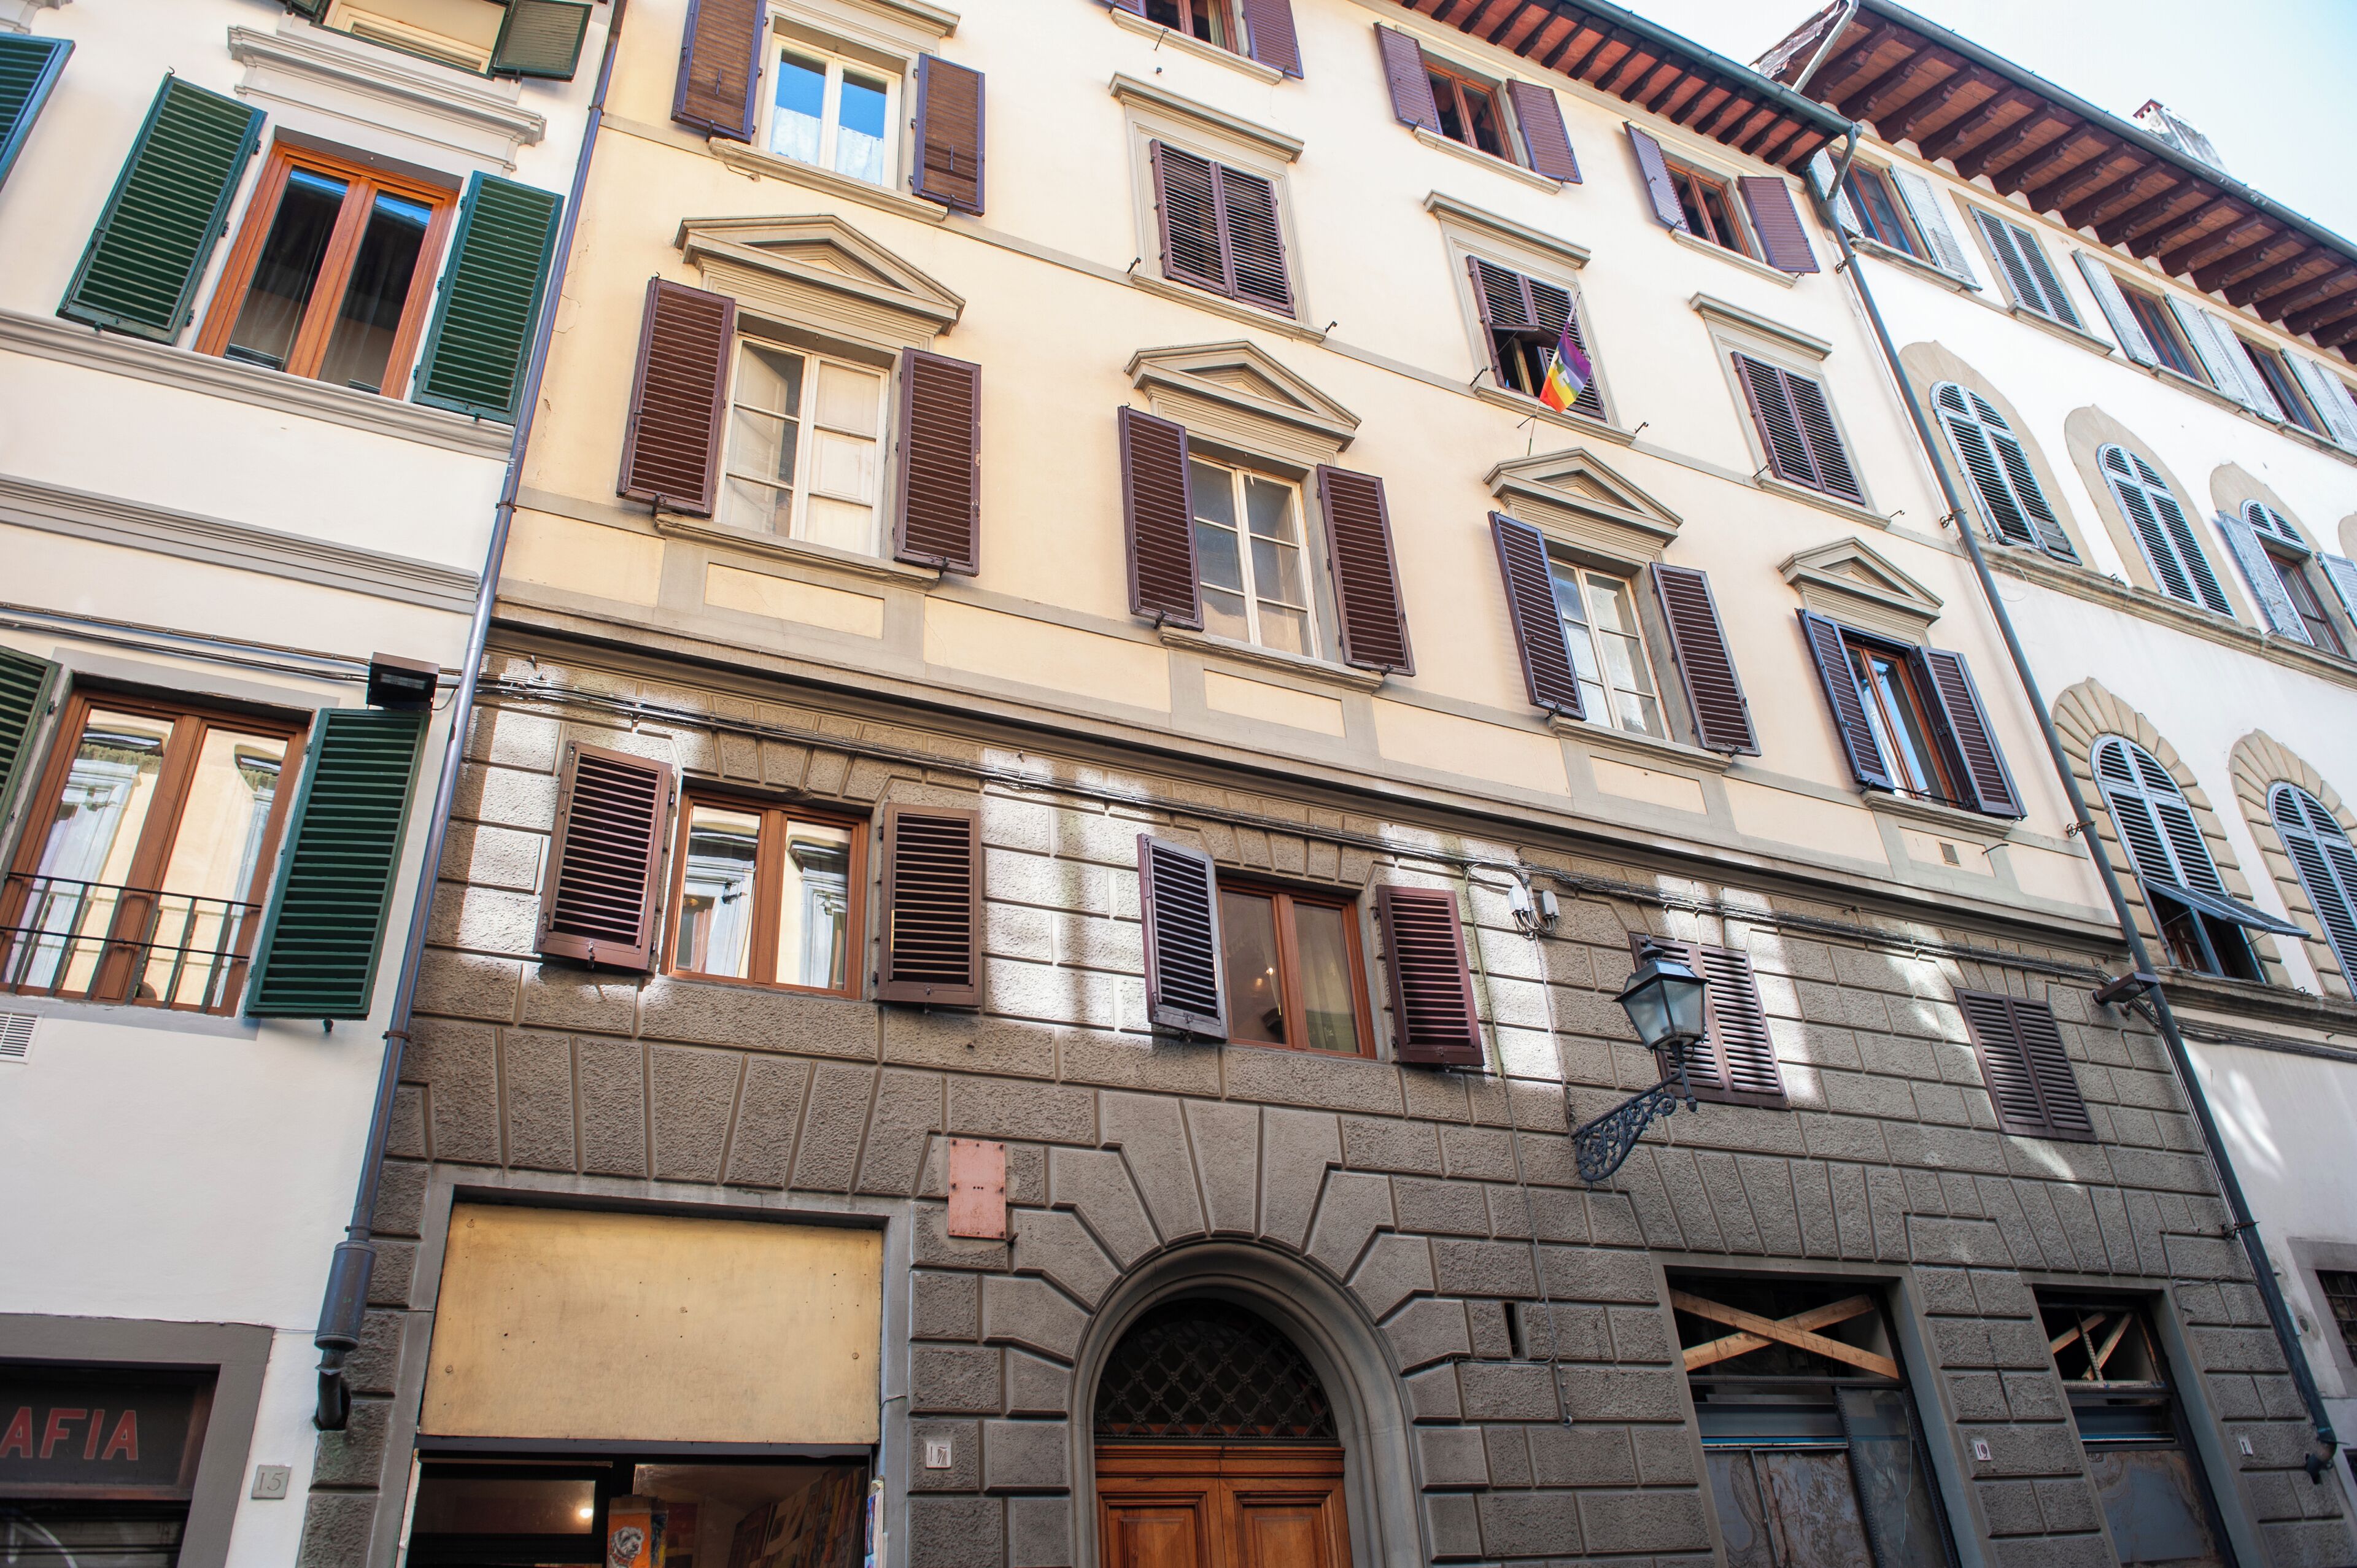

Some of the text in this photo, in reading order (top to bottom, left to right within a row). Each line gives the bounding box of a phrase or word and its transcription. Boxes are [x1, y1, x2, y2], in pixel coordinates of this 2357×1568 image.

[0, 1407, 138, 1460] AFIA
[930, 1446, 948, 1464] 17
[1976, 1443, 1987, 1459] 19
[259, 1472, 285, 1491] 15
